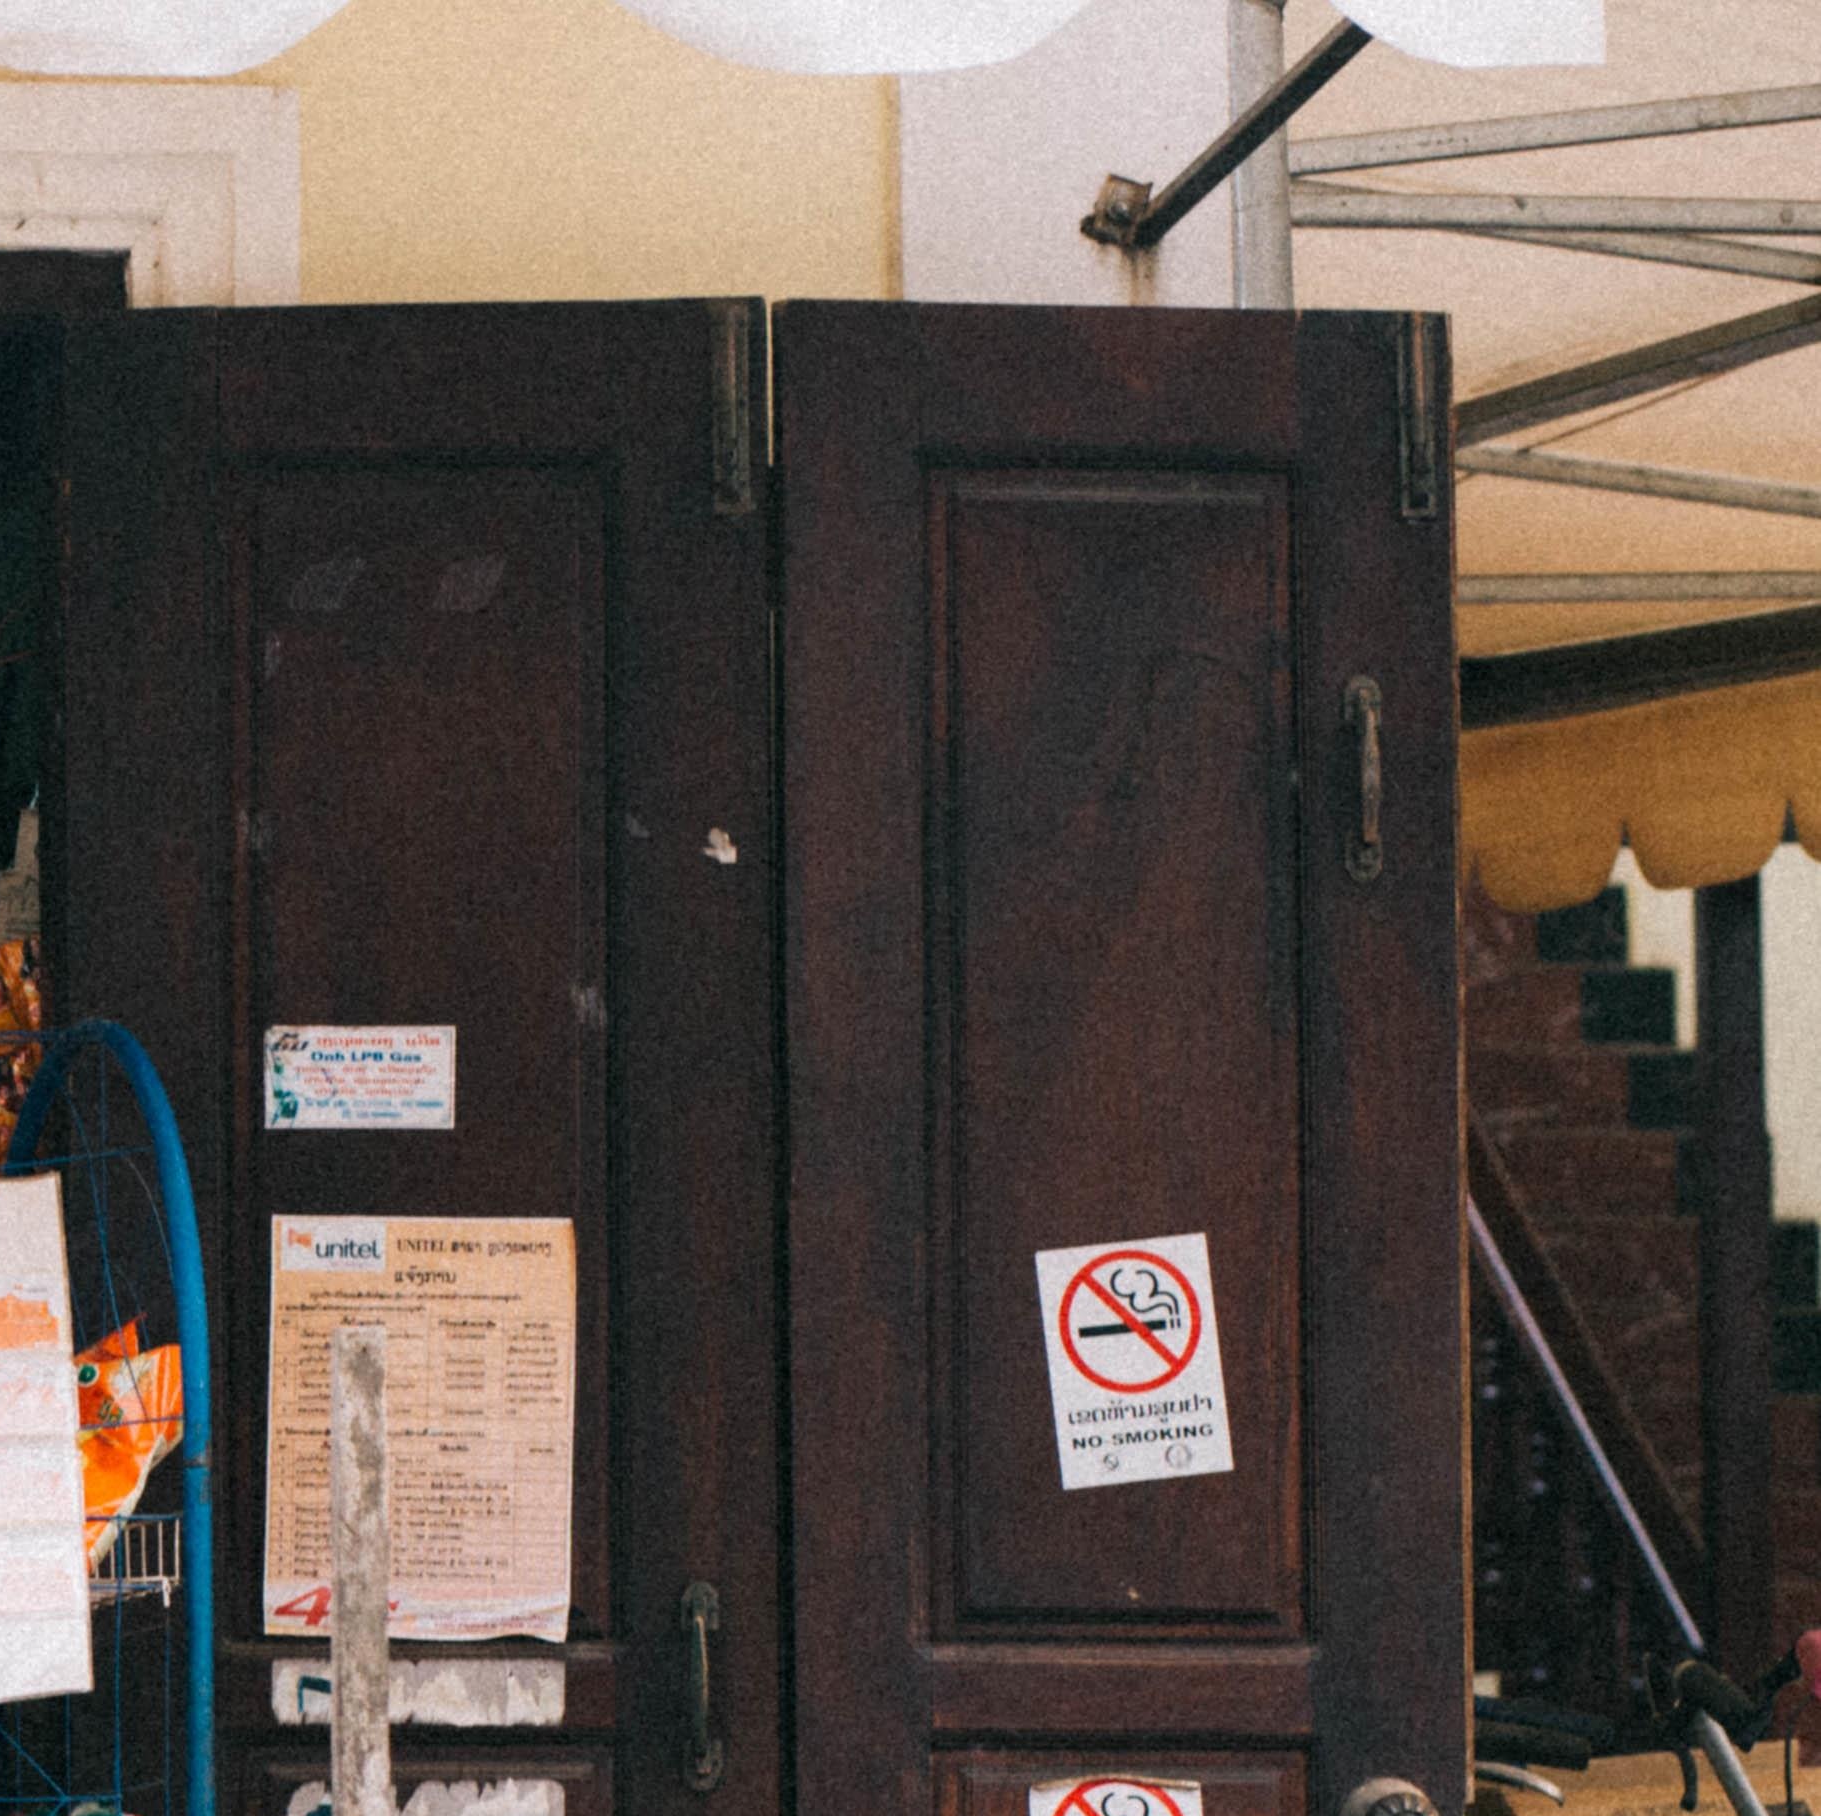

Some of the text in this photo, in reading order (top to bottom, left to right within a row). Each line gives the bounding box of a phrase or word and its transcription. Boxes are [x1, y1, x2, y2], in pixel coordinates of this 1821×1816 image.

[315, 1238, 381, 1260] unitel
[396, 1239, 445, 1252] UNITEL
[1072, 1424, 1214, 1450] NO SMOKING
